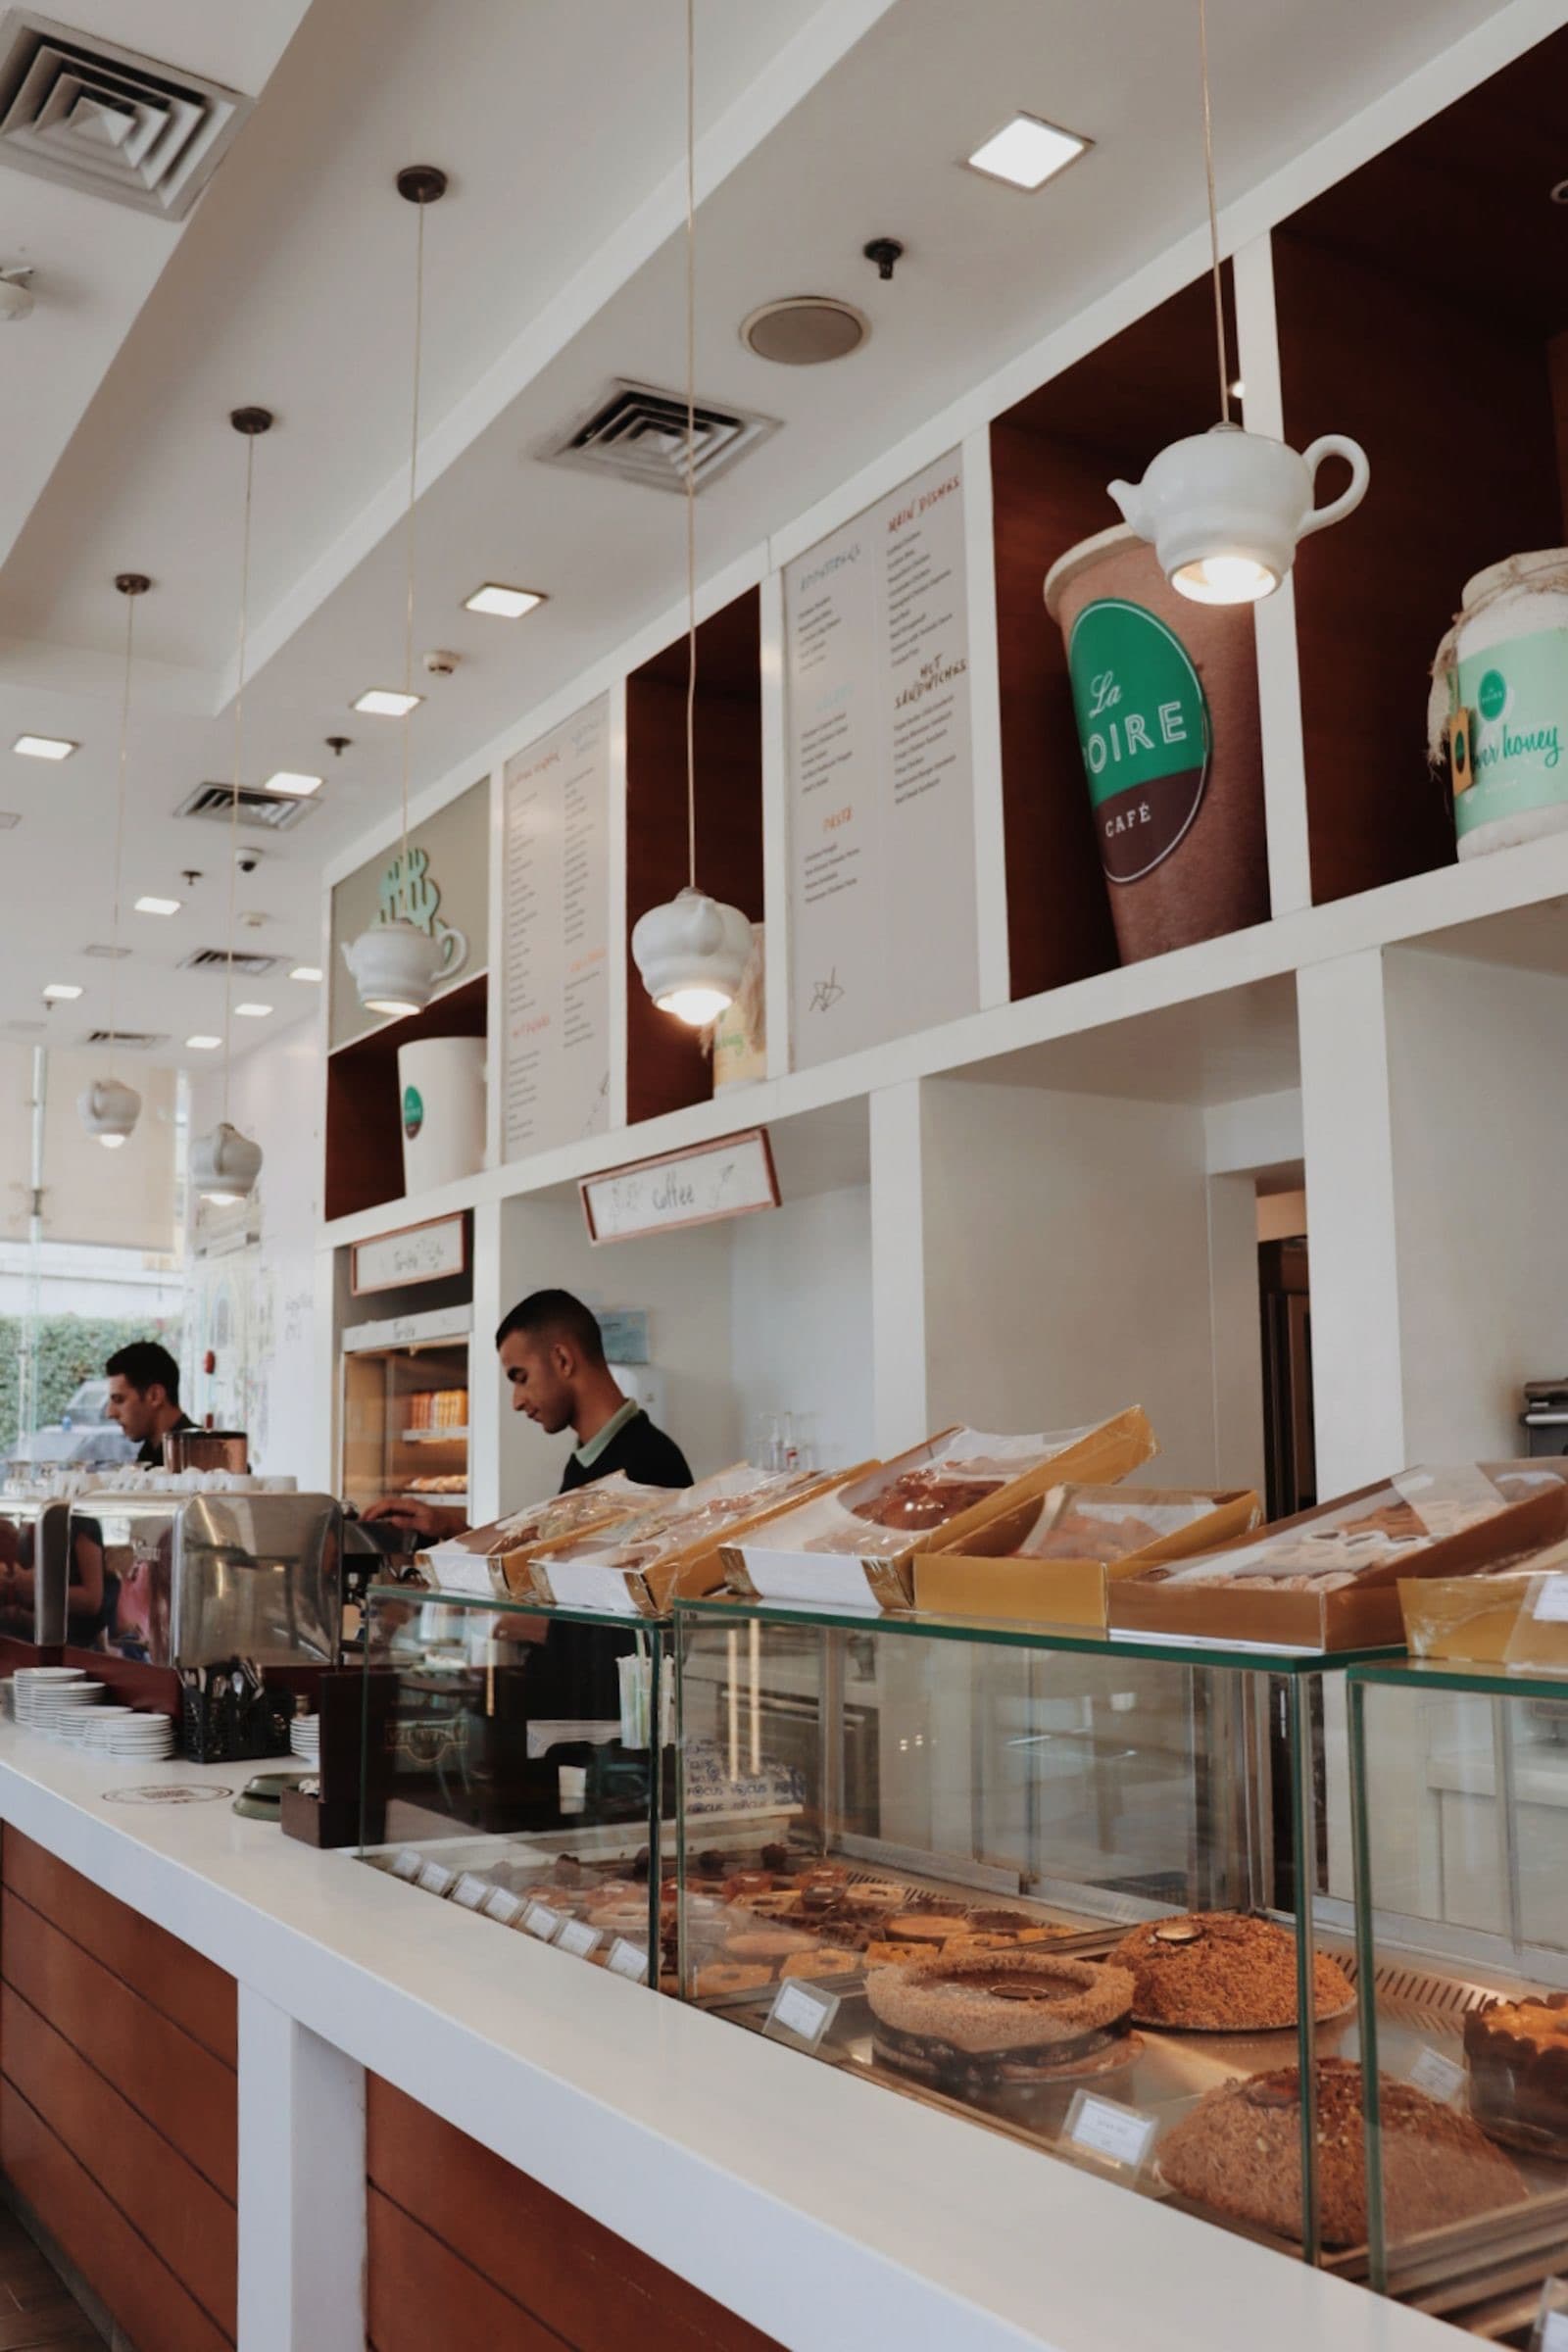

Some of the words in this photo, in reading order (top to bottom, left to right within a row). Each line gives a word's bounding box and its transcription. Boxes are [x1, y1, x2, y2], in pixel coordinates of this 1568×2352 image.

[1088, 669, 1122, 718] La
[1502, 723, 1564, 769] honey
[1104, 801, 1152, 838] CAFÉ
